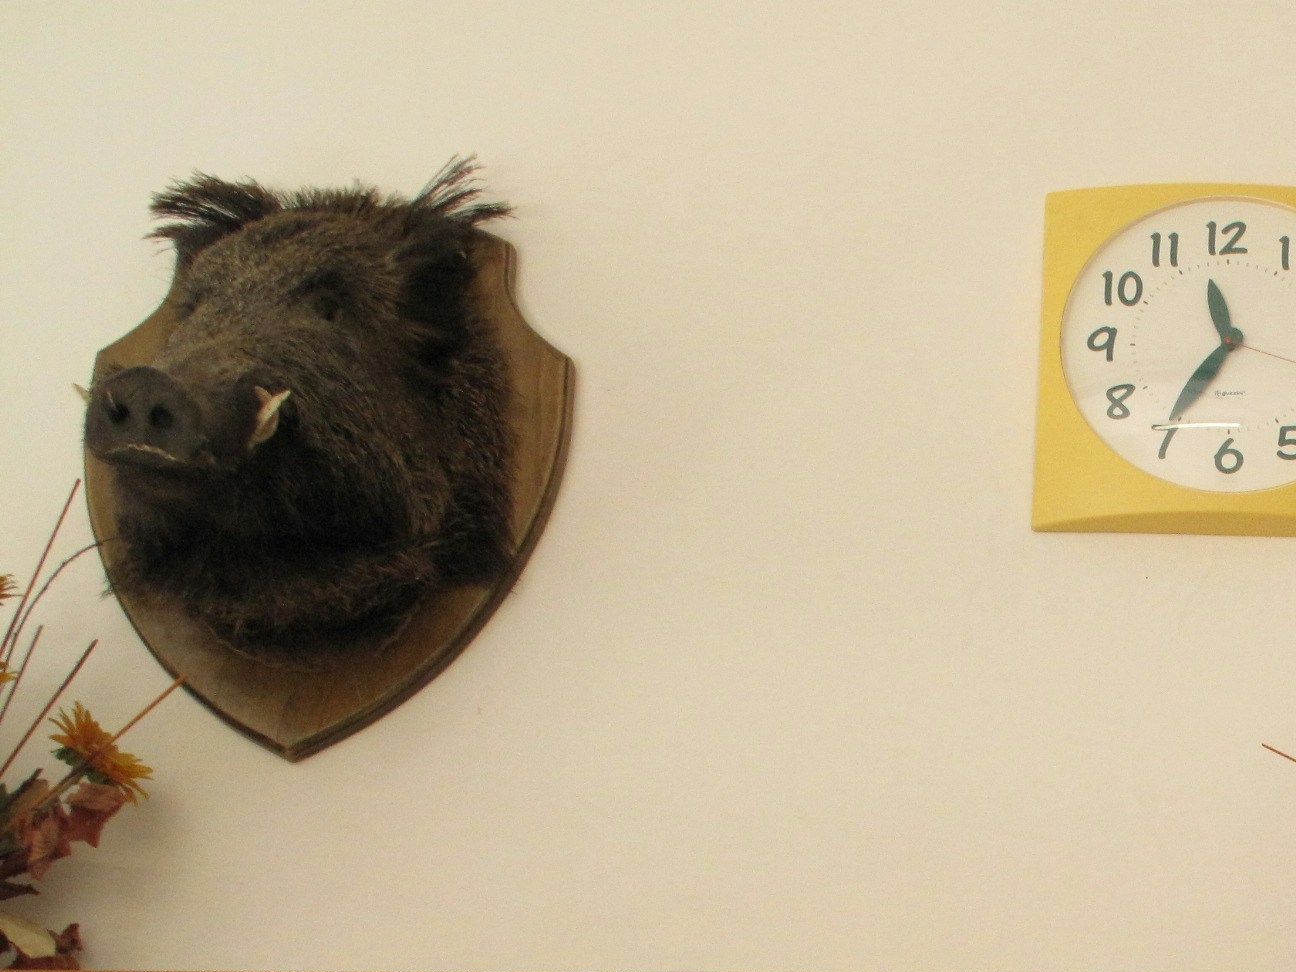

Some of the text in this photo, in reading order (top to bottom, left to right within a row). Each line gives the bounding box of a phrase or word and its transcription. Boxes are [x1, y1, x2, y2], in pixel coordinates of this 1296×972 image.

[1150, 231, 1179, 268] 11
[1206, 220, 1248, 256] 12
[1278, 235, 1290, 271] 1
[1102, 270, 1143, 306] 10
[1086, 326, 1118, 362] 9
[1105, 383, 1136, 420] 8
[1152, 423, 1180, 460] 7
[1213, 437, 1244, 474] 6
